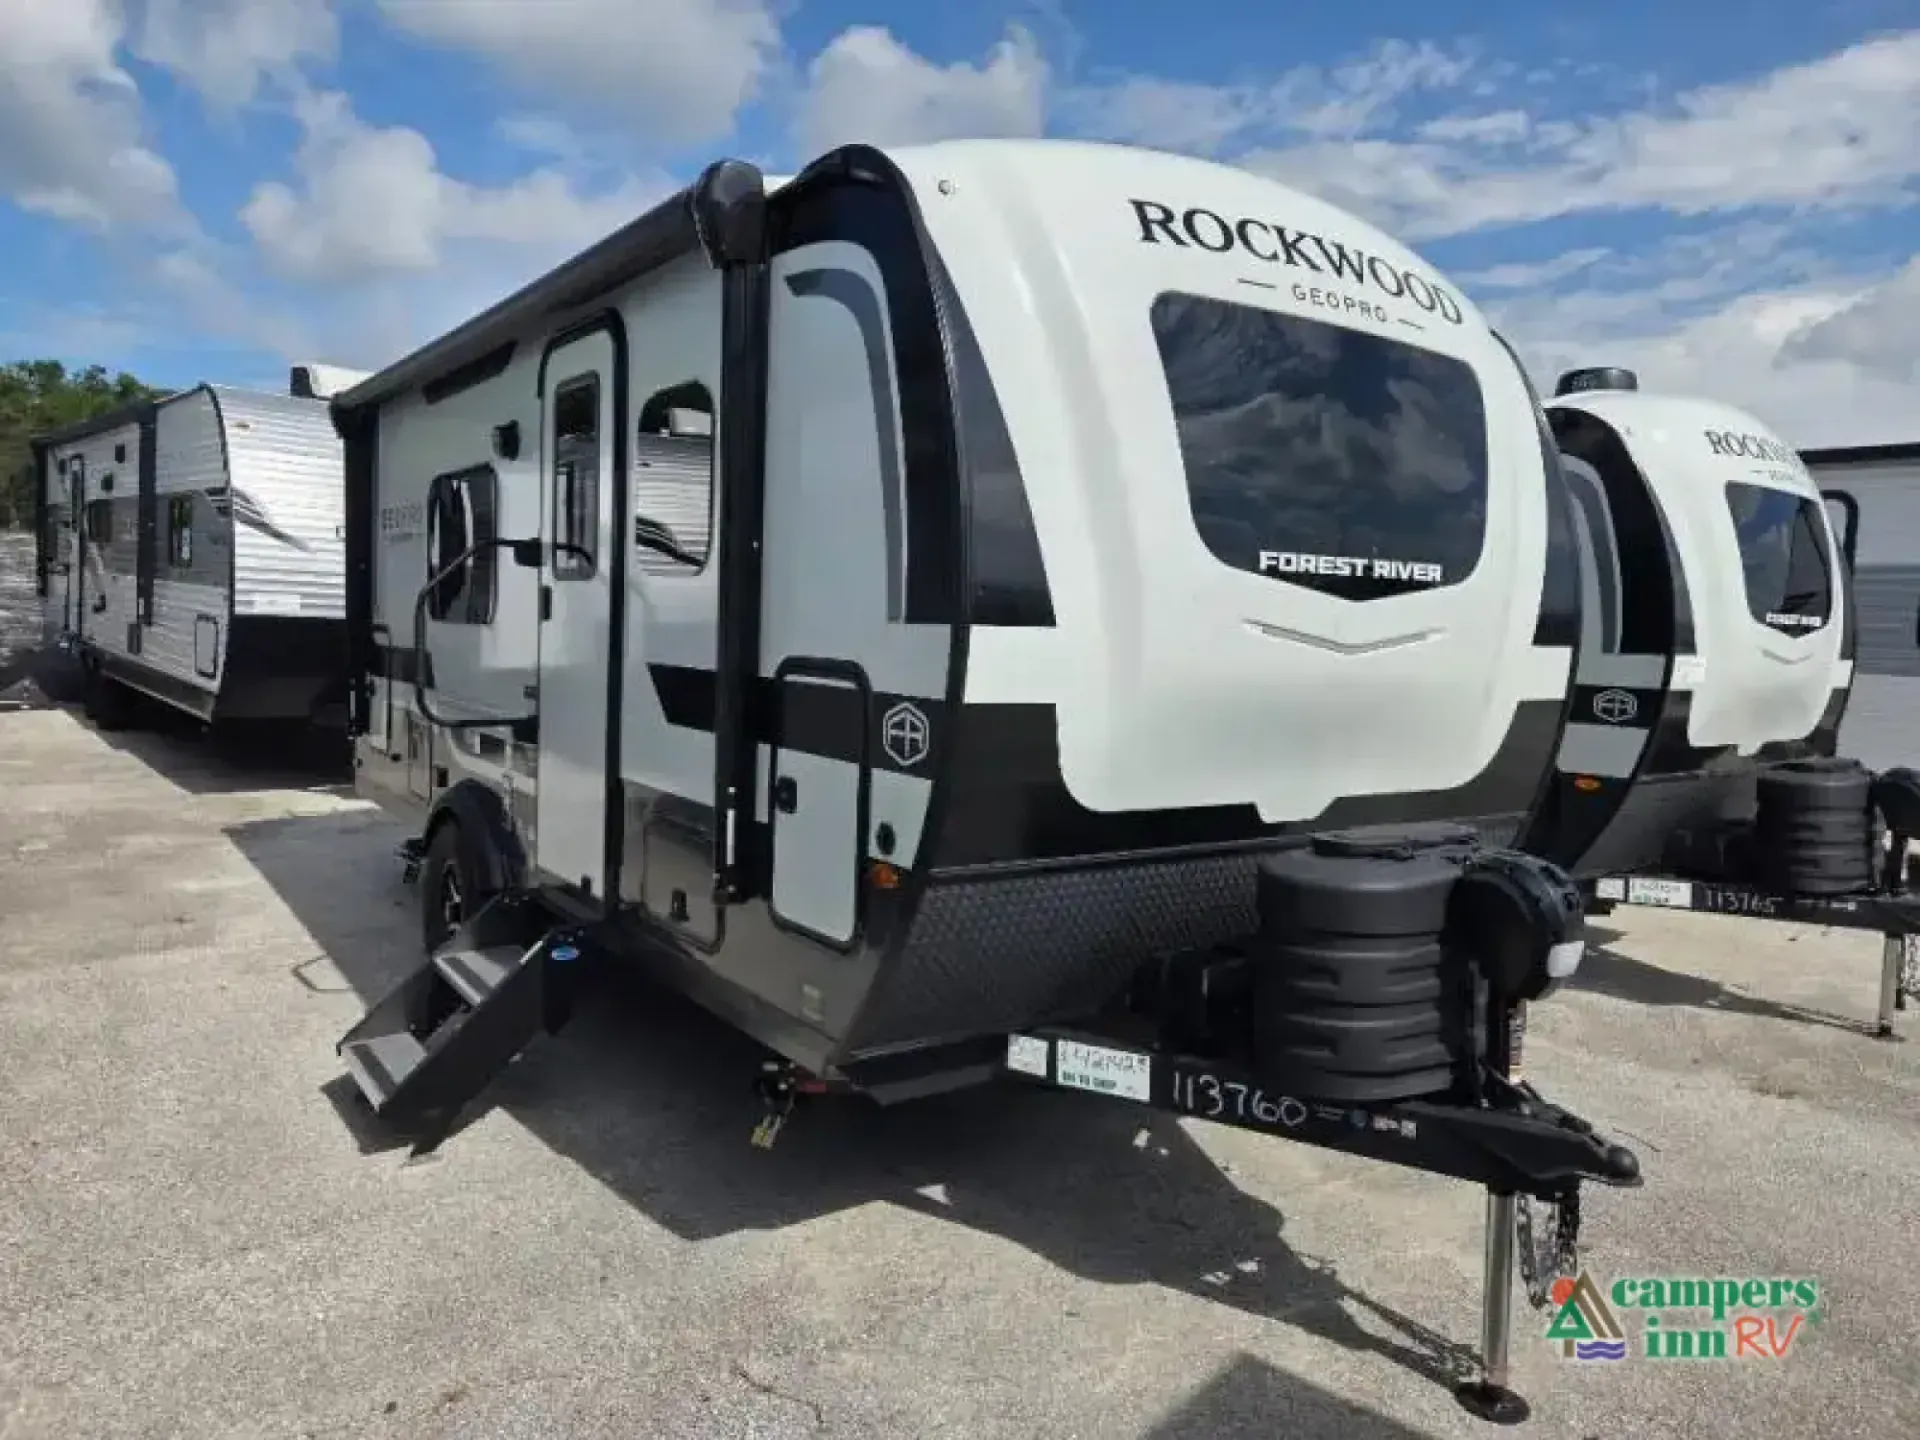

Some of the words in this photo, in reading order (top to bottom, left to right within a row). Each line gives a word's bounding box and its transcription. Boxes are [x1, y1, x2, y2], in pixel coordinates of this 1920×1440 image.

[1128, 198, 1463, 325] ROCKWOOD
[1290, 283, 1388, 323] GEOPRO
[1259, 550, 1369, 577] FOREST
[1372, 558, 1442, 582] RIVER
[1173, 1071, 1308, 1126] 113760
